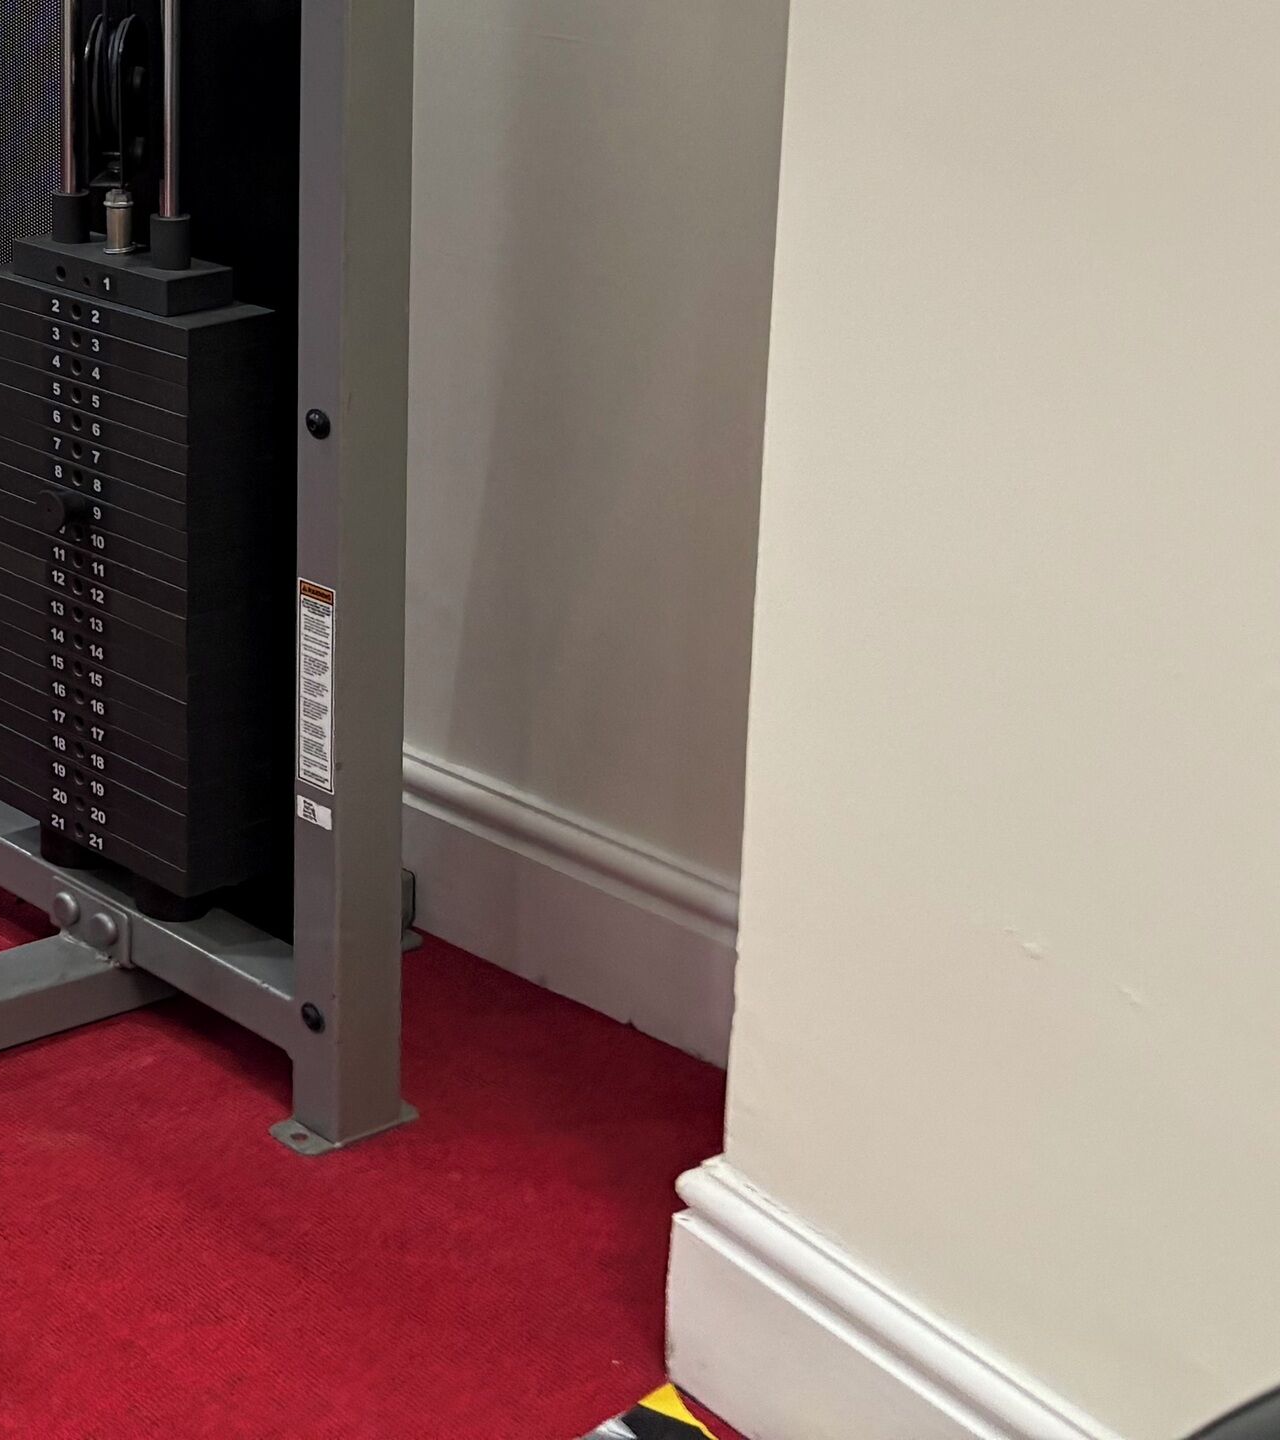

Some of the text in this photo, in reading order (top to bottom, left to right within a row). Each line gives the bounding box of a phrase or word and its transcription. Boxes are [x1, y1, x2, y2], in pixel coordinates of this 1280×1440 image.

[103, 277, 110, 291] 1
[51, 299, 100, 324] 2 2
[52, 327, 100, 352] 3 3
[52, 355, 100, 380] 4 4
[52, 382, 100, 408] 5 5
[53, 410, 100, 436] 6 6
[53, 436, 100, 464] 7 7
[54, 465, 102, 492] 8 8
[93, 506, 101, 520] 9
[91, 534, 105, 549] 10
[53, 546, 104, 577] 11 11
[51, 570, 104, 604] 12 12
[50, 600, 103, 633] 13 13
[50, 627, 104, 660] 14 14
[50, 654, 103, 687] 15 15
[52, 681, 105, 715] 16 16
[52, 708, 105, 741] 17 17
[52, 735, 105, 770] 18 18
[52, 762, 105, 797] 19 19
[52, 787, 106, 824] 20 20
[51, 813, 103, 850] 21 21
